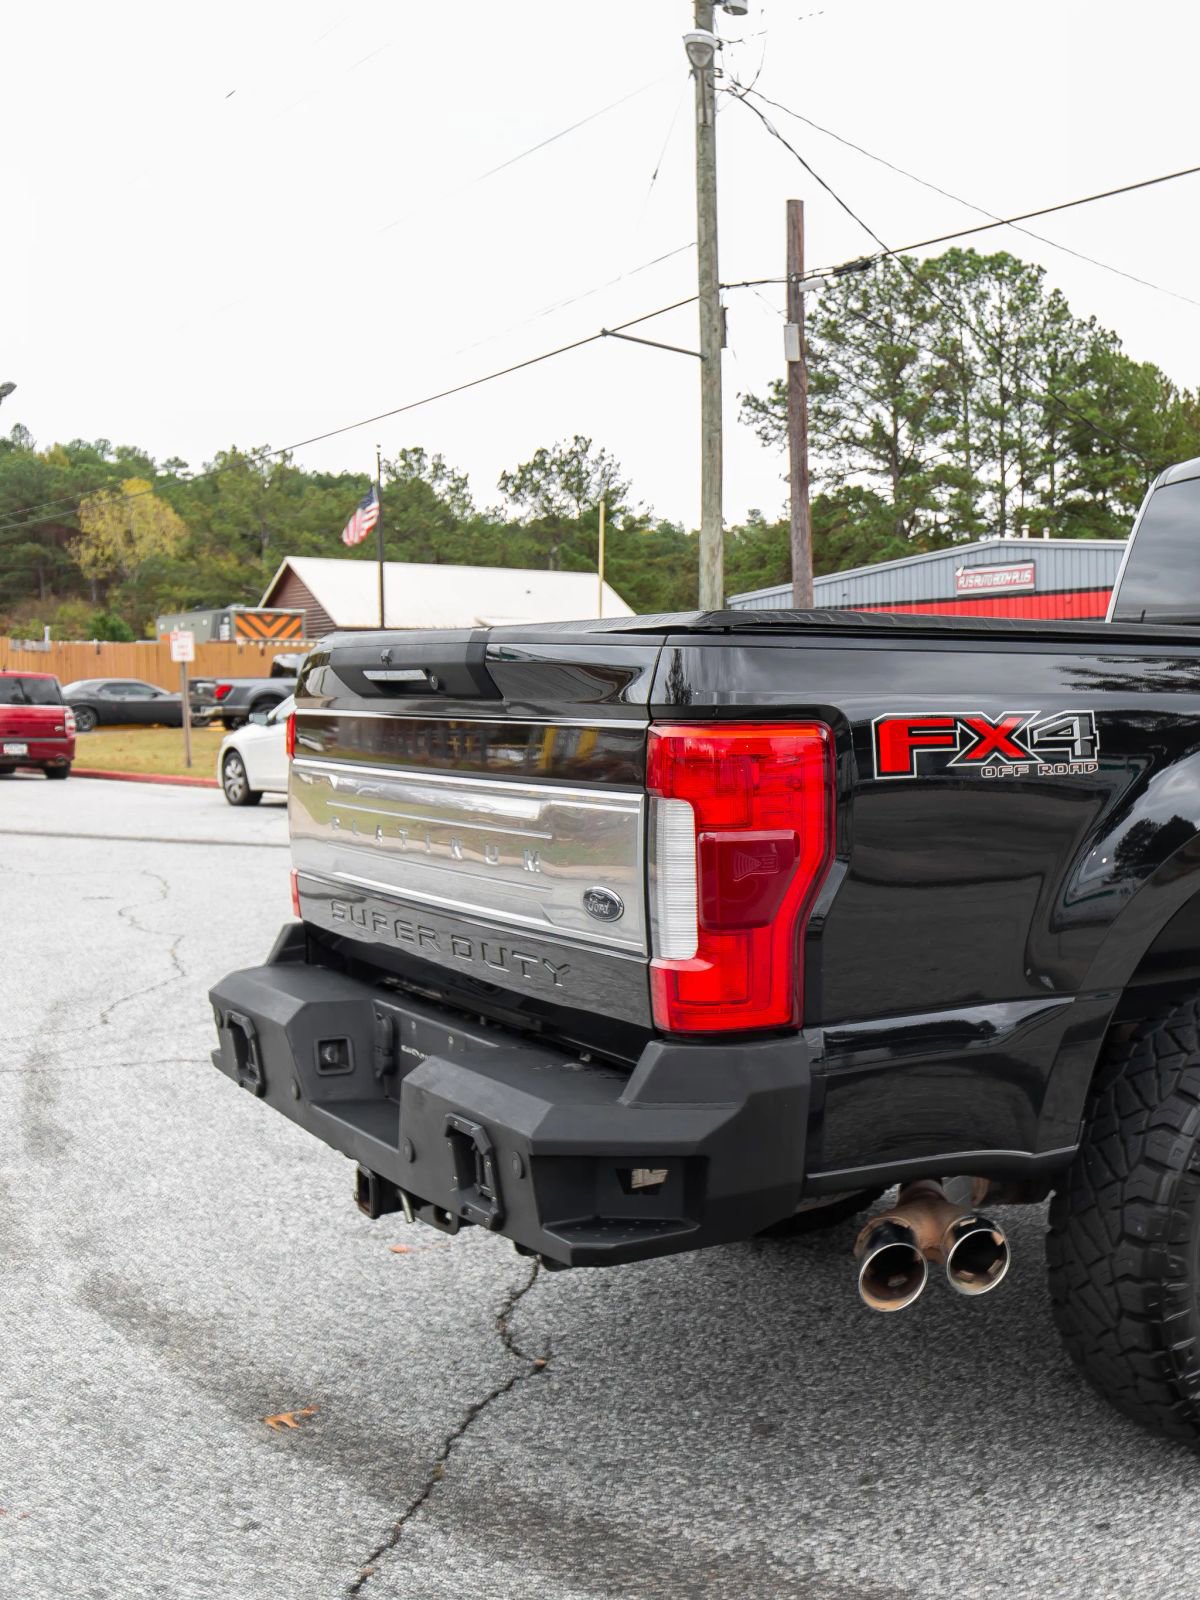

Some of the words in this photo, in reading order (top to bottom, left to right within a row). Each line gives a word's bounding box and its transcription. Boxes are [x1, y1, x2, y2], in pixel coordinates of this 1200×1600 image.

[872, 710, 1099, 780] FX4
[981, 765, 1029, 778] OFF
[1037, 762, 1099, 776] ROAD
[330, 815, 541, 872] PLATINUM
[330, 899, 442, 953] SUPER
[450, 934, 571, 987] DUTY
